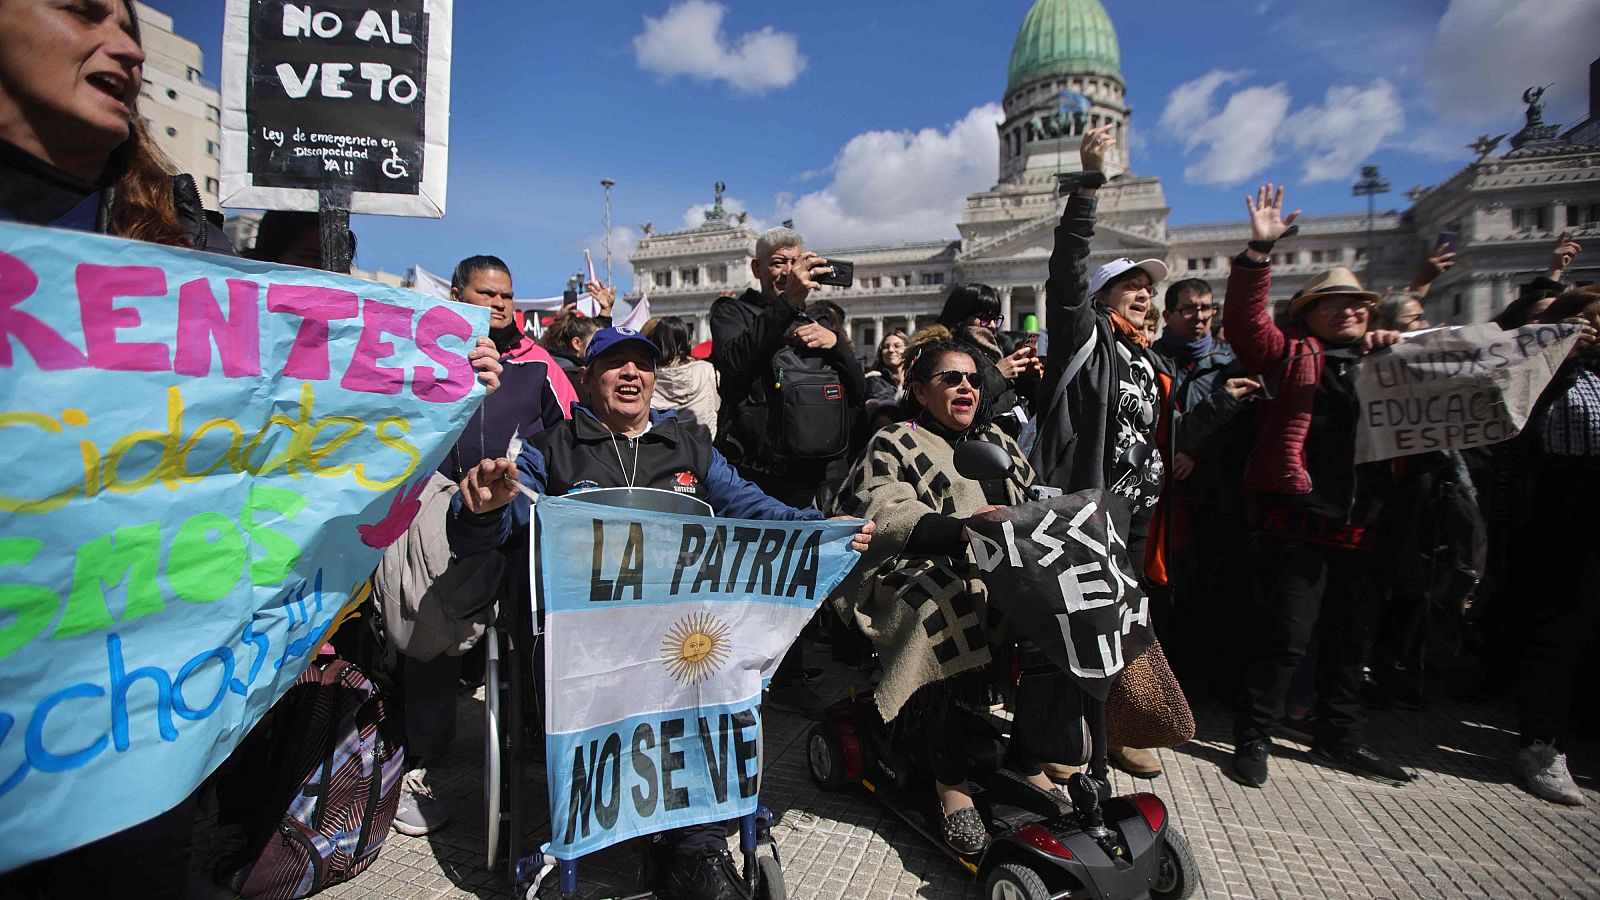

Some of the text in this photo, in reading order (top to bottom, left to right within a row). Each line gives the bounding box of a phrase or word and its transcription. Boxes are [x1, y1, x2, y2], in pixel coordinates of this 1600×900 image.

[282, 3, 413, 44] NO AL
[275, 62, 418, 105] VETO
[262, 126, 396, 148] Ley de emergencia en
[294, 146, 369, 160] Discapacidad
[0, 250, 475, 403] RENTES
[589, 518, 644, 602] LA
[669, 523, 824, 601] PATRIA
[564, 703, 761, 846] NO SE VE
